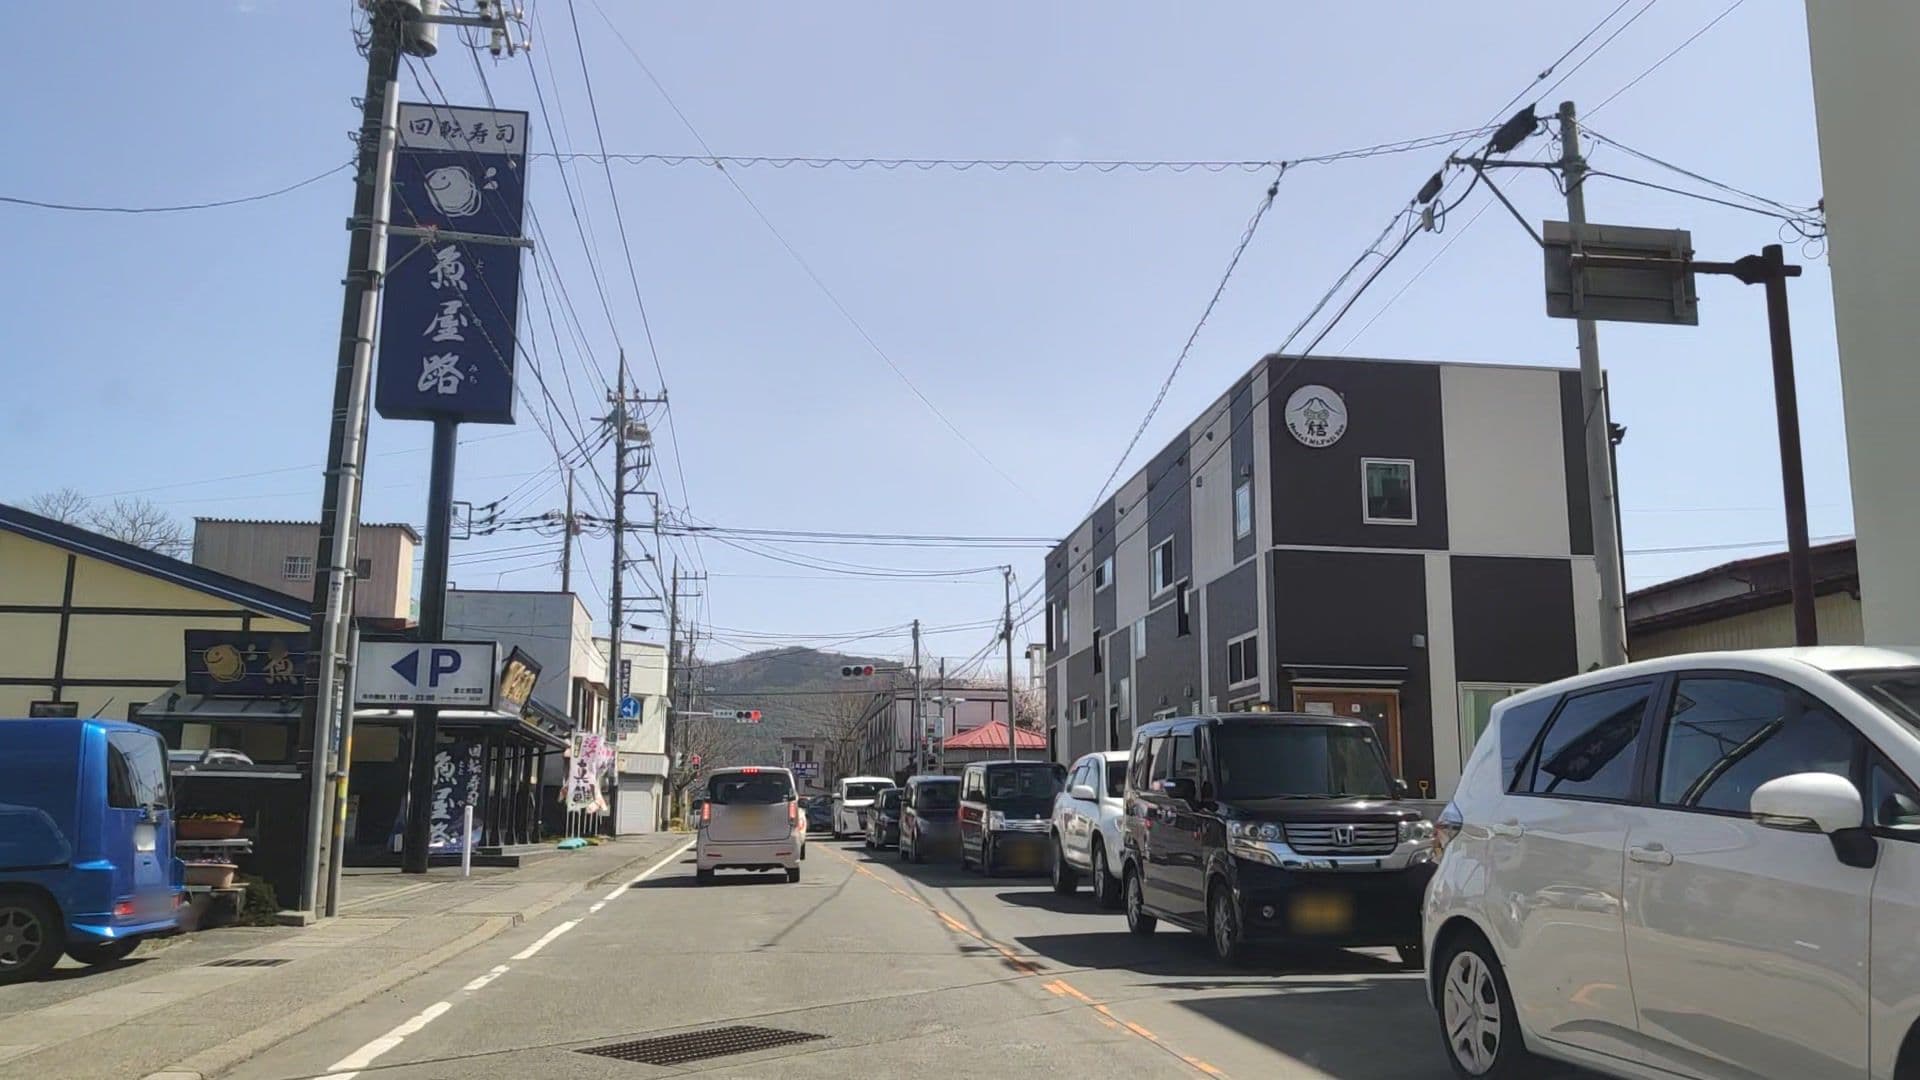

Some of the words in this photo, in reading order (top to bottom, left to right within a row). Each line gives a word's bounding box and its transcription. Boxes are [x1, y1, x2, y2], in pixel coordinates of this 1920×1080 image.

[409, 118, 515, 143] 回転寿司
[417, 245, 468, 394] 魚屋路
[429, 648, 462, 687] P
